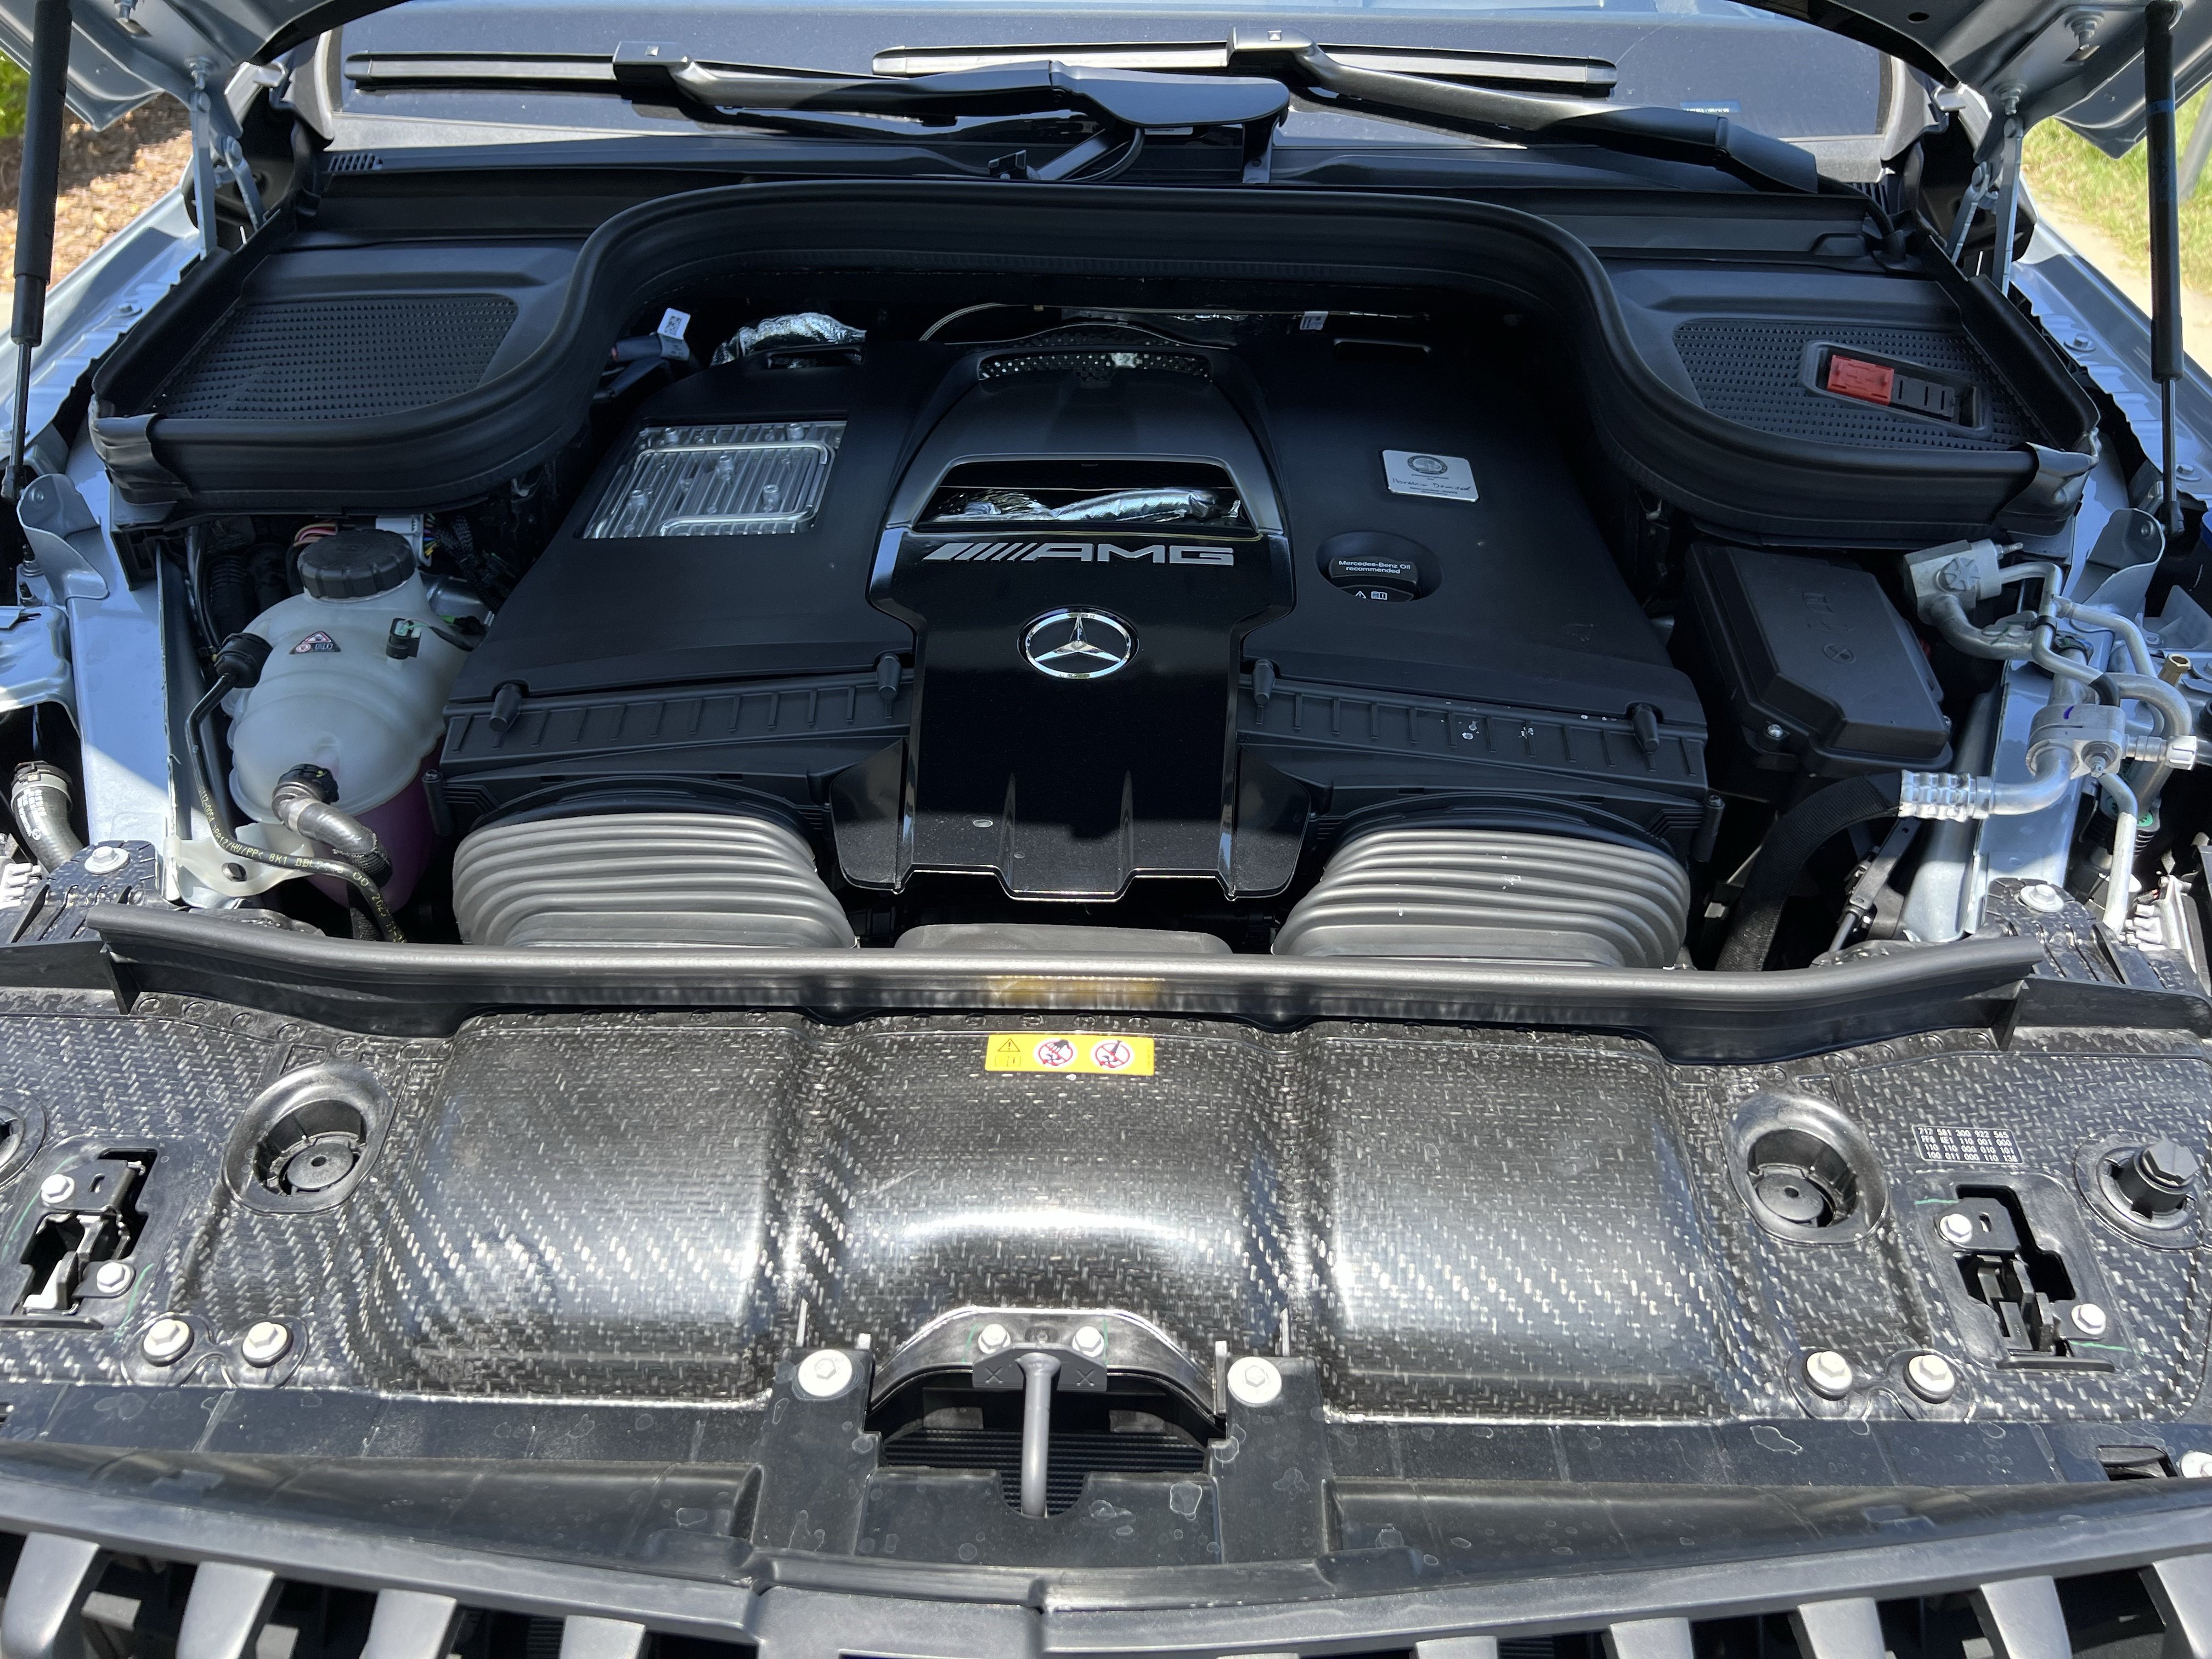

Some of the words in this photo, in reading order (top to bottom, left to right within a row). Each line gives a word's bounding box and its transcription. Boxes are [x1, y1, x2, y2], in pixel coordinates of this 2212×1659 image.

[1020, 542, 1234, 566] AMG
[1338, 560, 1398, 569] Mercedes-Benz
[1346, 566, 1401, 574] recommended
[1955, 1129, 1972, 1137] 300
[1977, 1138, 1993, 1146] 001
[1996, 1138, 2012, 1147] 000
[1924, 1143, 1940, 1152] 110
[1943, 1144, 1958, 1153] 110
[1961, 1145, 1977, 1153] 000
[1980, 1146, 1996, 1154] 010
[2000, 1147, 2015, 1155] 101
[1927, 1151, 1942, 1159] 100
[1945, 1152, 1960, 1160] 011
[1963, 1153, 1980, 1161] 000
